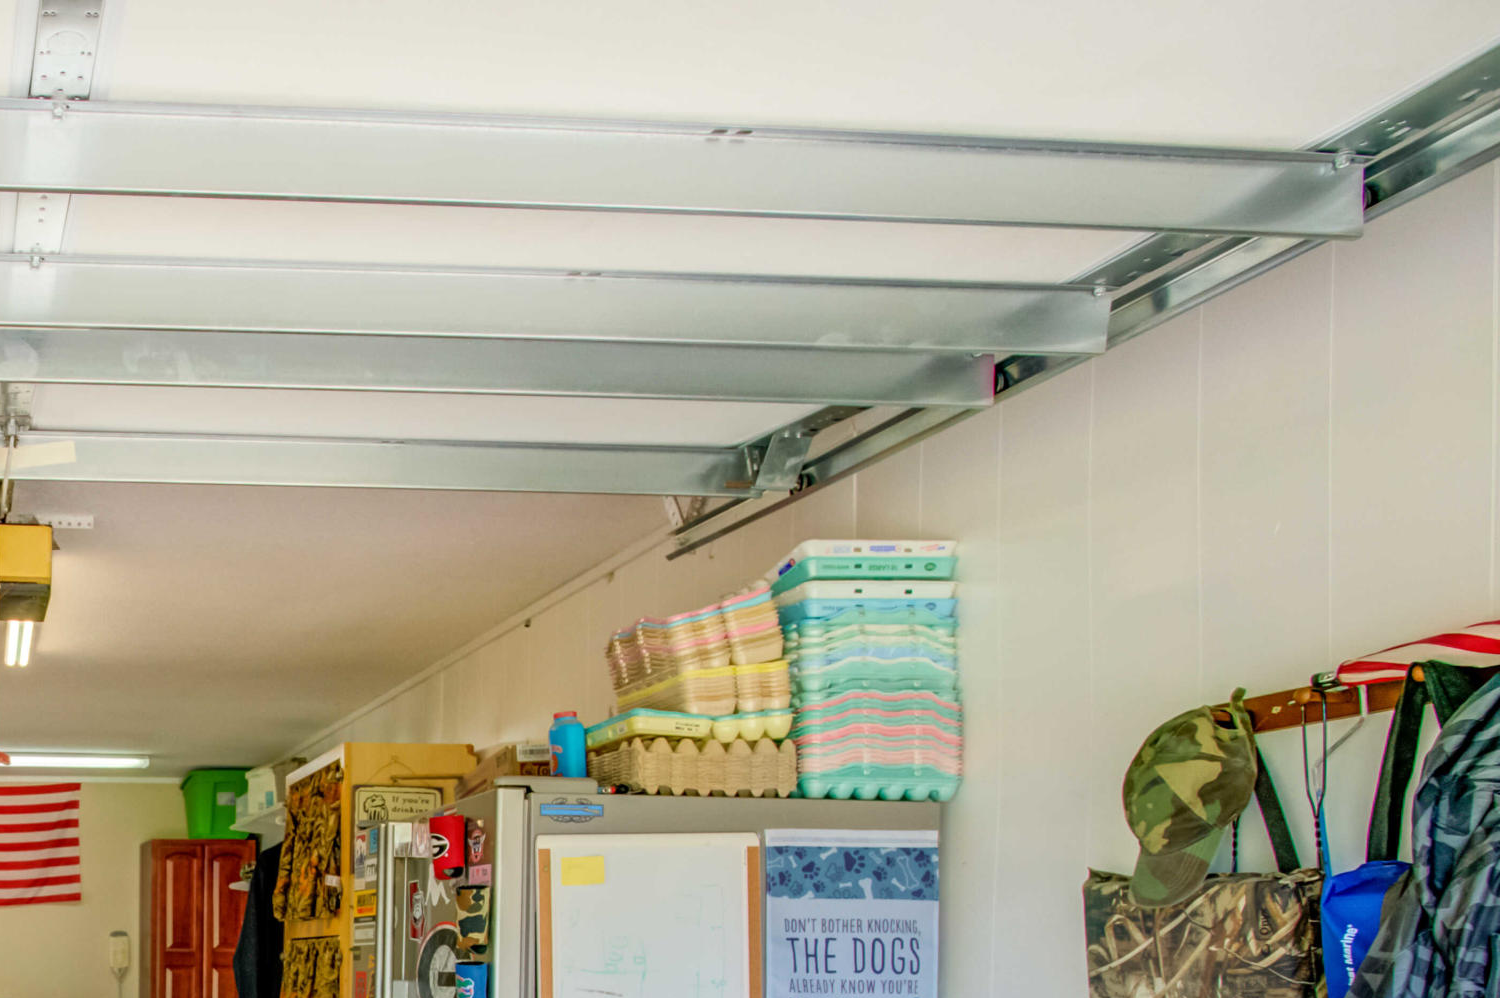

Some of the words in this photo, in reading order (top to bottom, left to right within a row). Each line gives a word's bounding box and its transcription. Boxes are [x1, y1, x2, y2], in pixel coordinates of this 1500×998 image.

[784, 918, 817, 933] DON'T
[821, 918, 863, 934] BOTHER
[868, 919, 921, 936] KNOCKING,
[786, 937, 837, 974] THE
[852, 937, 920, 975] DOGS
[789, 978, 835, 994] ALREADY
[840, 978, 876, 994] KNOW
[881, 979, 919, 994] YOU'RE
